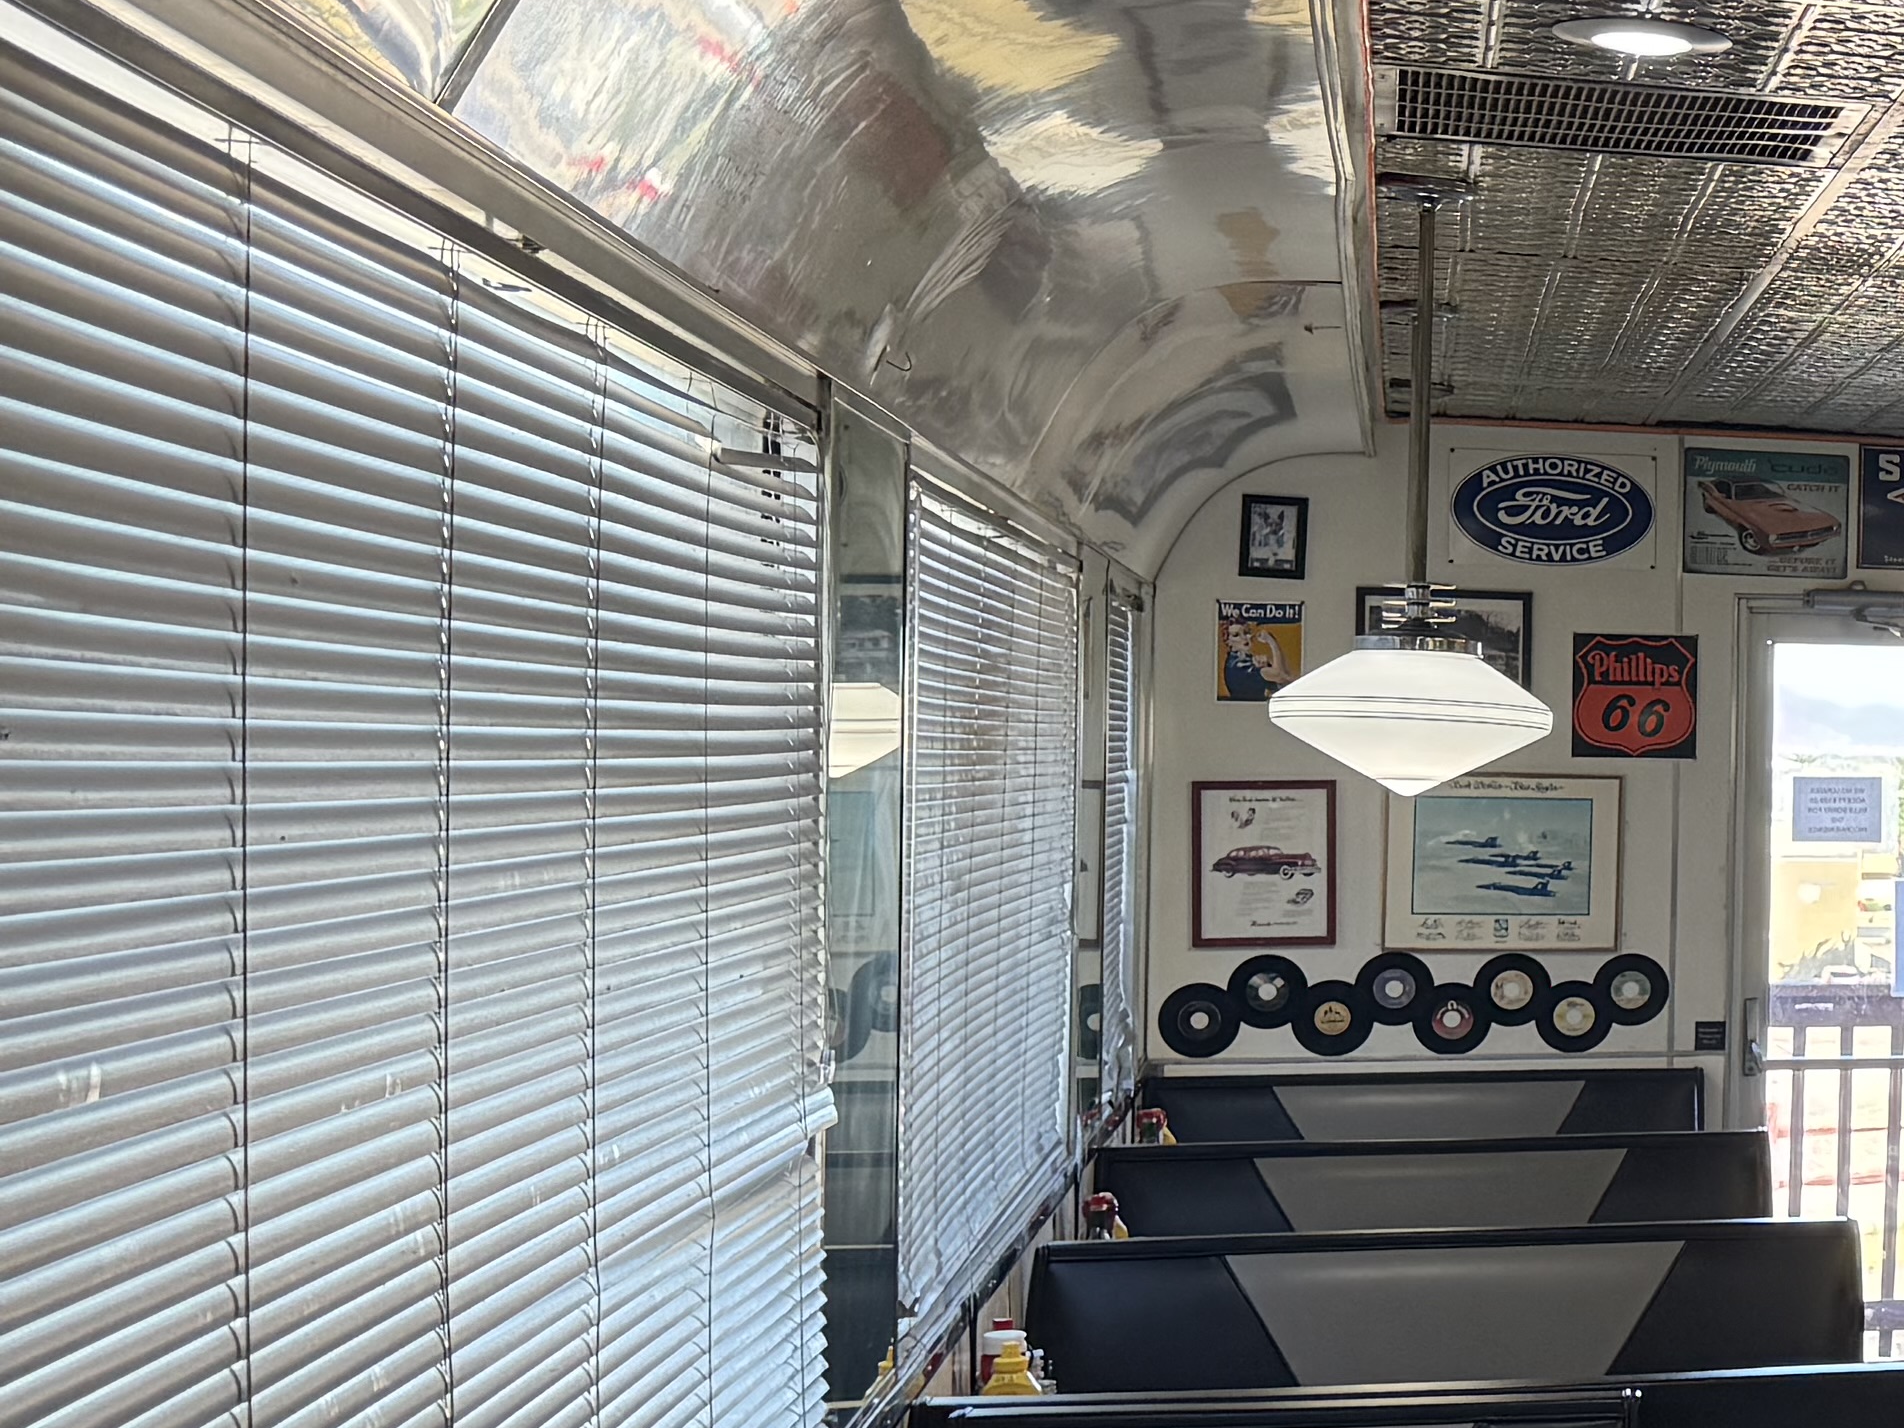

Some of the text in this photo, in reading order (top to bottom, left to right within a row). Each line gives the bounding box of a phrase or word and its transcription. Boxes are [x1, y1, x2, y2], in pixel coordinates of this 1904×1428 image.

[1481, 458, 1631, 494] AUTHORIZED
[1694, 455, 1757, 474] Plymouth
[1497, 486, 1611, 526] Ford
[1498, 536, 1607, 561] SERVICE
[1221, 603, 1299, 619] We Can Do It!
[1587, 650, 1680, 690] Phillips
[1602, 693, 1671, 738] 66
